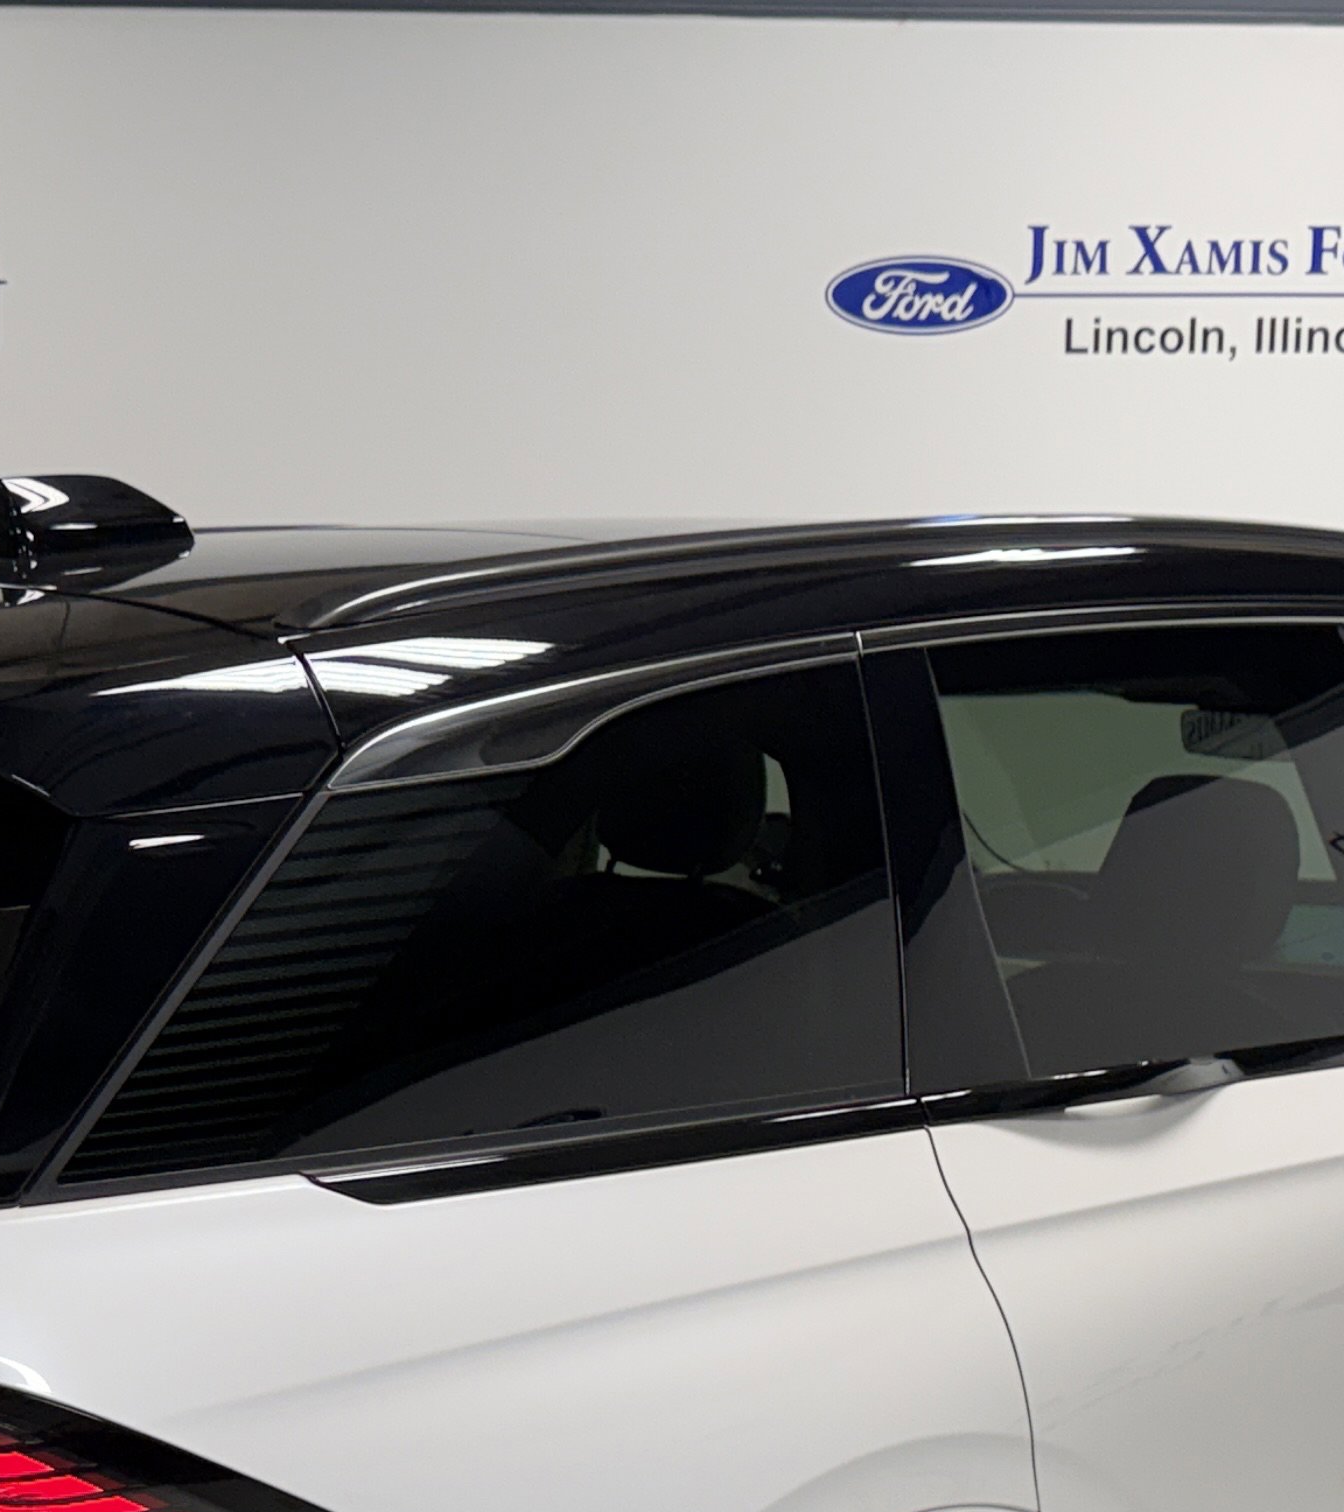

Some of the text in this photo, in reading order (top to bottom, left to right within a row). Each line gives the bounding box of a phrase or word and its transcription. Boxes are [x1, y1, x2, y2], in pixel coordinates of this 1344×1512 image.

[1024, 224, 1110, 286] JIM
[1125, 224, 1290, 276] XAMIS
[861, 268, 978, 322] Ford
[1064, 316, 1238, 361] Lincoln,
